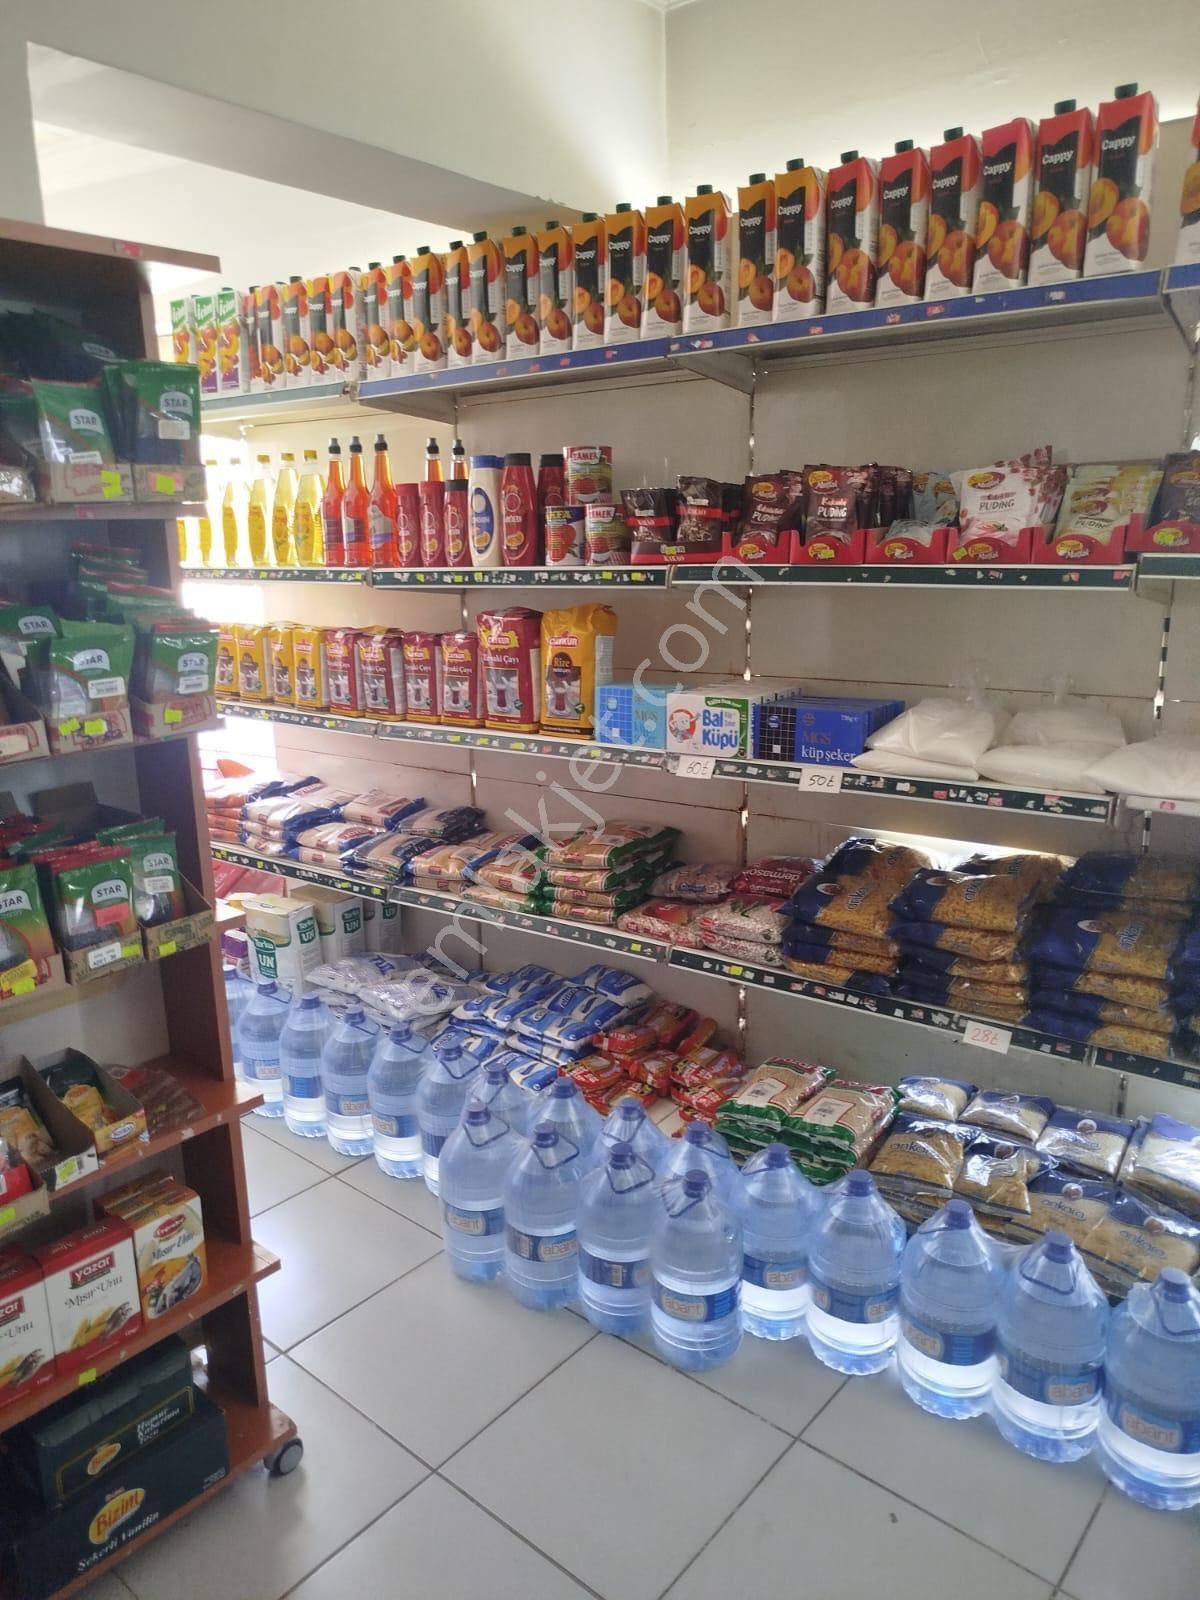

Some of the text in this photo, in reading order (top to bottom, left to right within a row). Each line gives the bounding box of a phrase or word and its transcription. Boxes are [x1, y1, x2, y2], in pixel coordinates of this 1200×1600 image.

[1102, 135, 1137, 151] Cappy
[1042, 149, 1075, 166] Cappy
[983, 161, 1013, 176] Cappy
[932, 174, 959, 190] Cappy
[883, 186, 909, 201] Cappy
[778, 203, 803, 216] Cappy
[830, 196, 854, 210] Cappy
[164, 398, 188, 408] STAR
[75, 415, 98, 426] STAR
[23, 621, 49, 631] STAR
[554, 657, 570, 668] Rize
[702, 709, 723, 728] Bal
[702, 730, 738, 749] Küpü
[801, 745, 824, 762] küp
[96, 884, 123, 899] STAR
[346, 919, 359, 931] UN
[301, 931, 316, 942] UN
[258, 953, 276, 969] UN
[74, 1255, 112, 1282] yazar
[1125, 1413, 1175, 1444] abant
